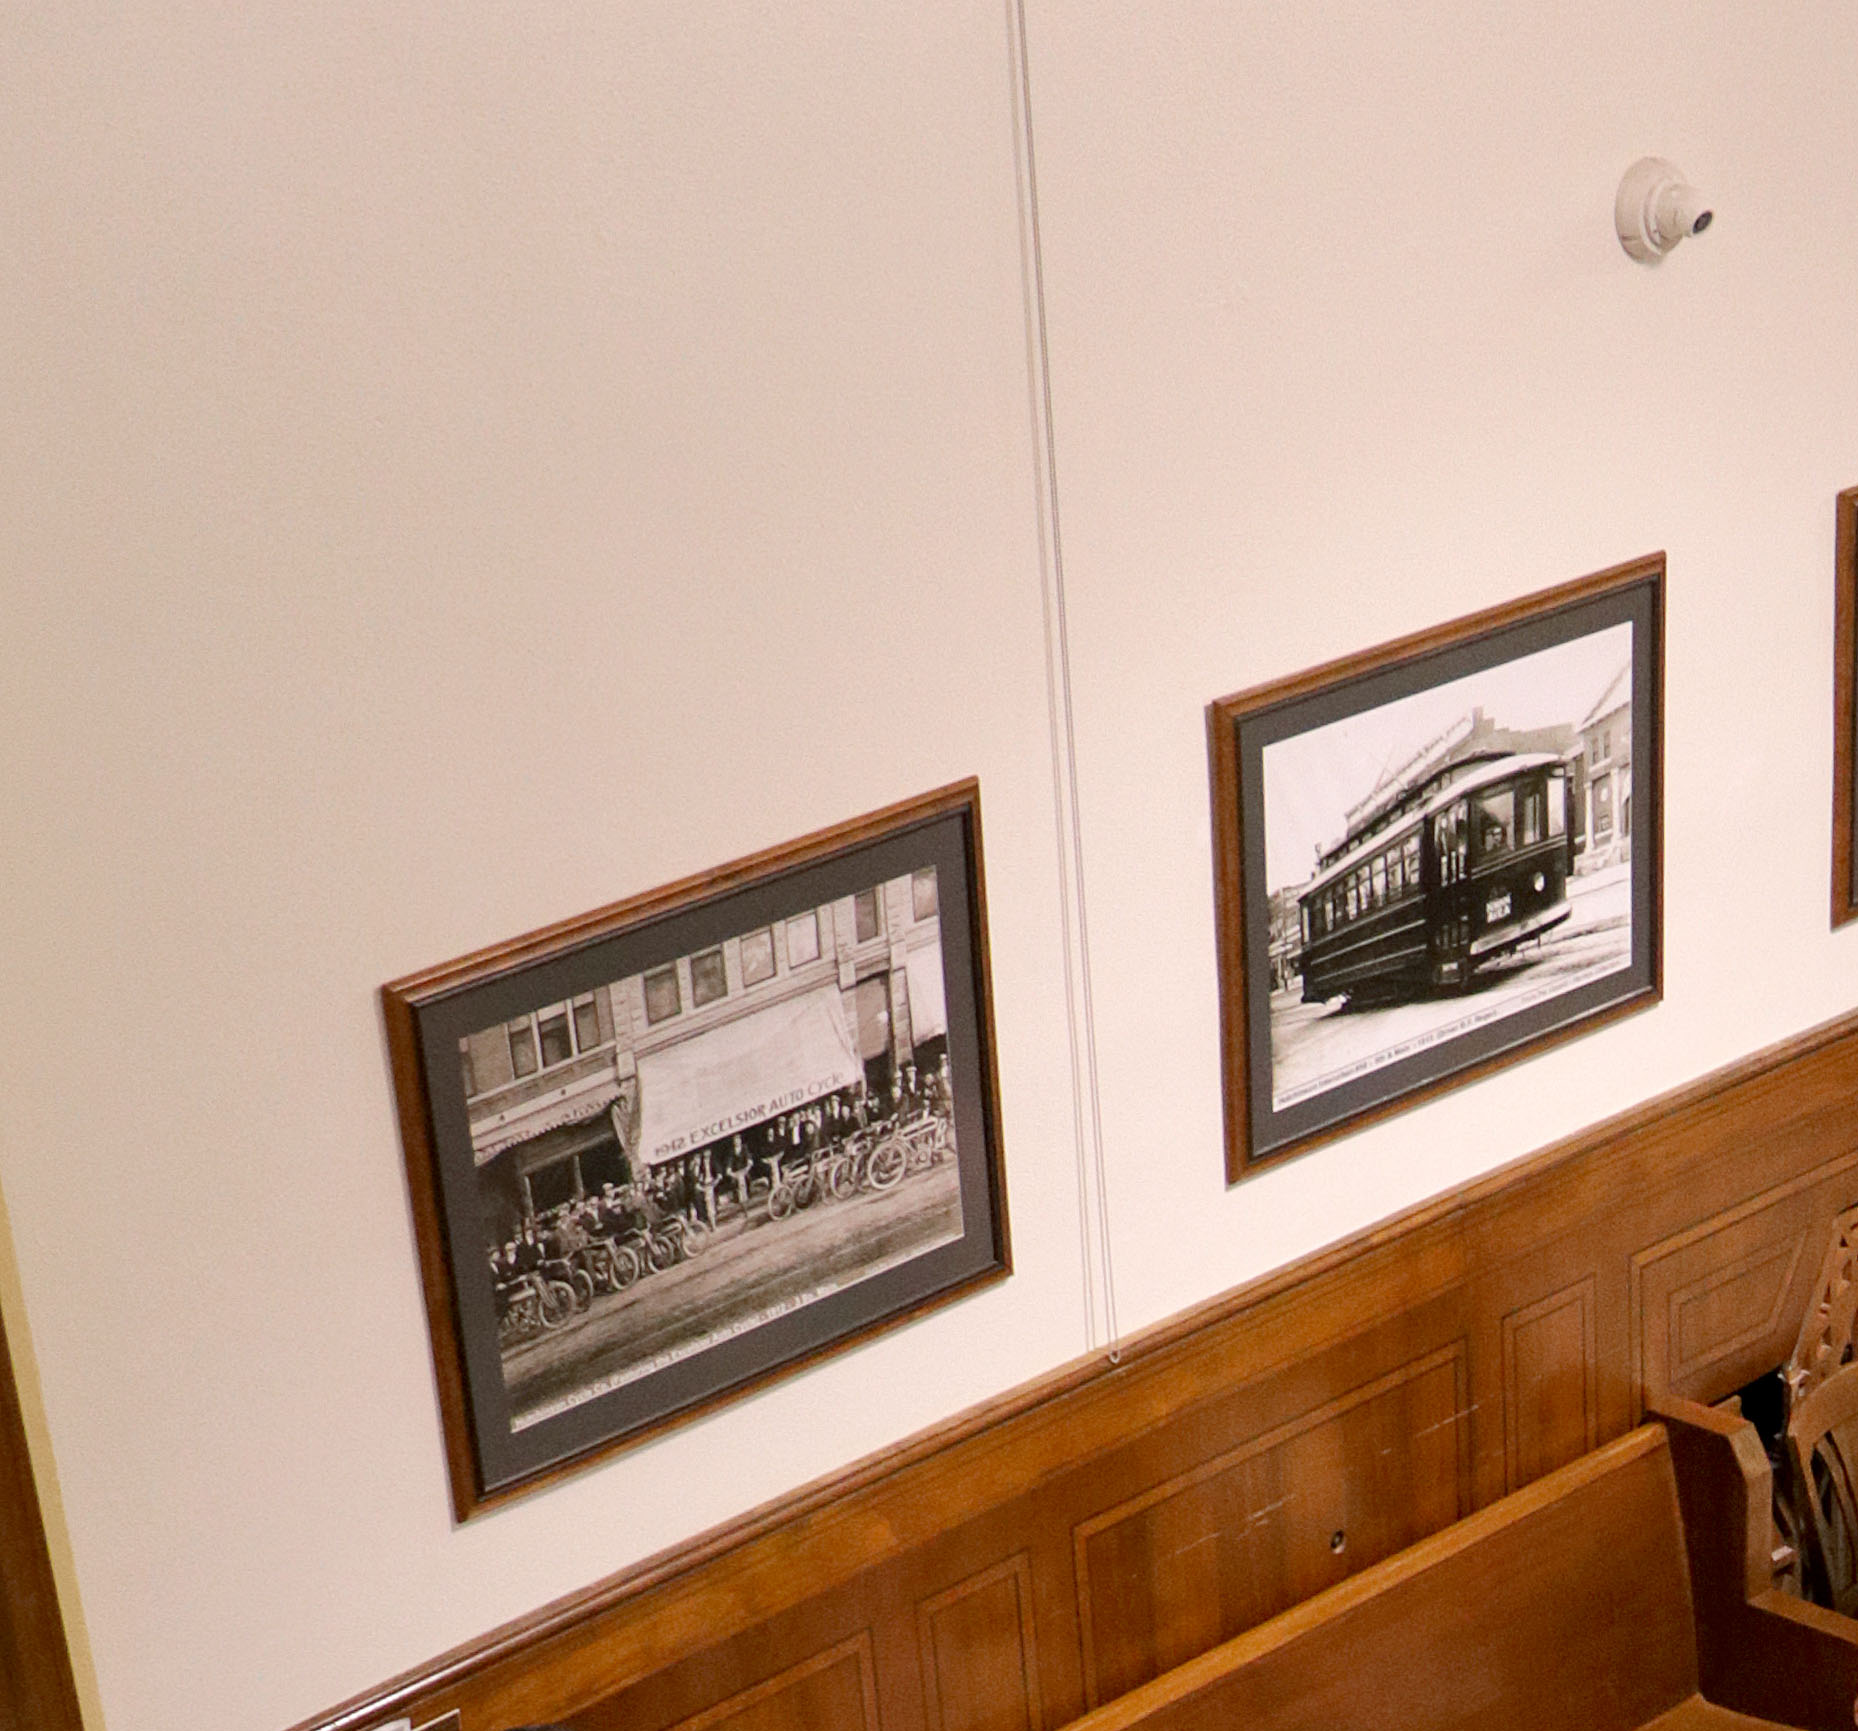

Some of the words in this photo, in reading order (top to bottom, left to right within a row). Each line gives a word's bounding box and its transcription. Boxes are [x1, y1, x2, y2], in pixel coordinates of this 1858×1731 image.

[654, 1138, 685, 1156] 1912
[689, 1104, 766, 1145] EXCELSIOR
[769, 1088, 804, 1112] AUTO
[808, 1071, 845, 1097] Cycle
